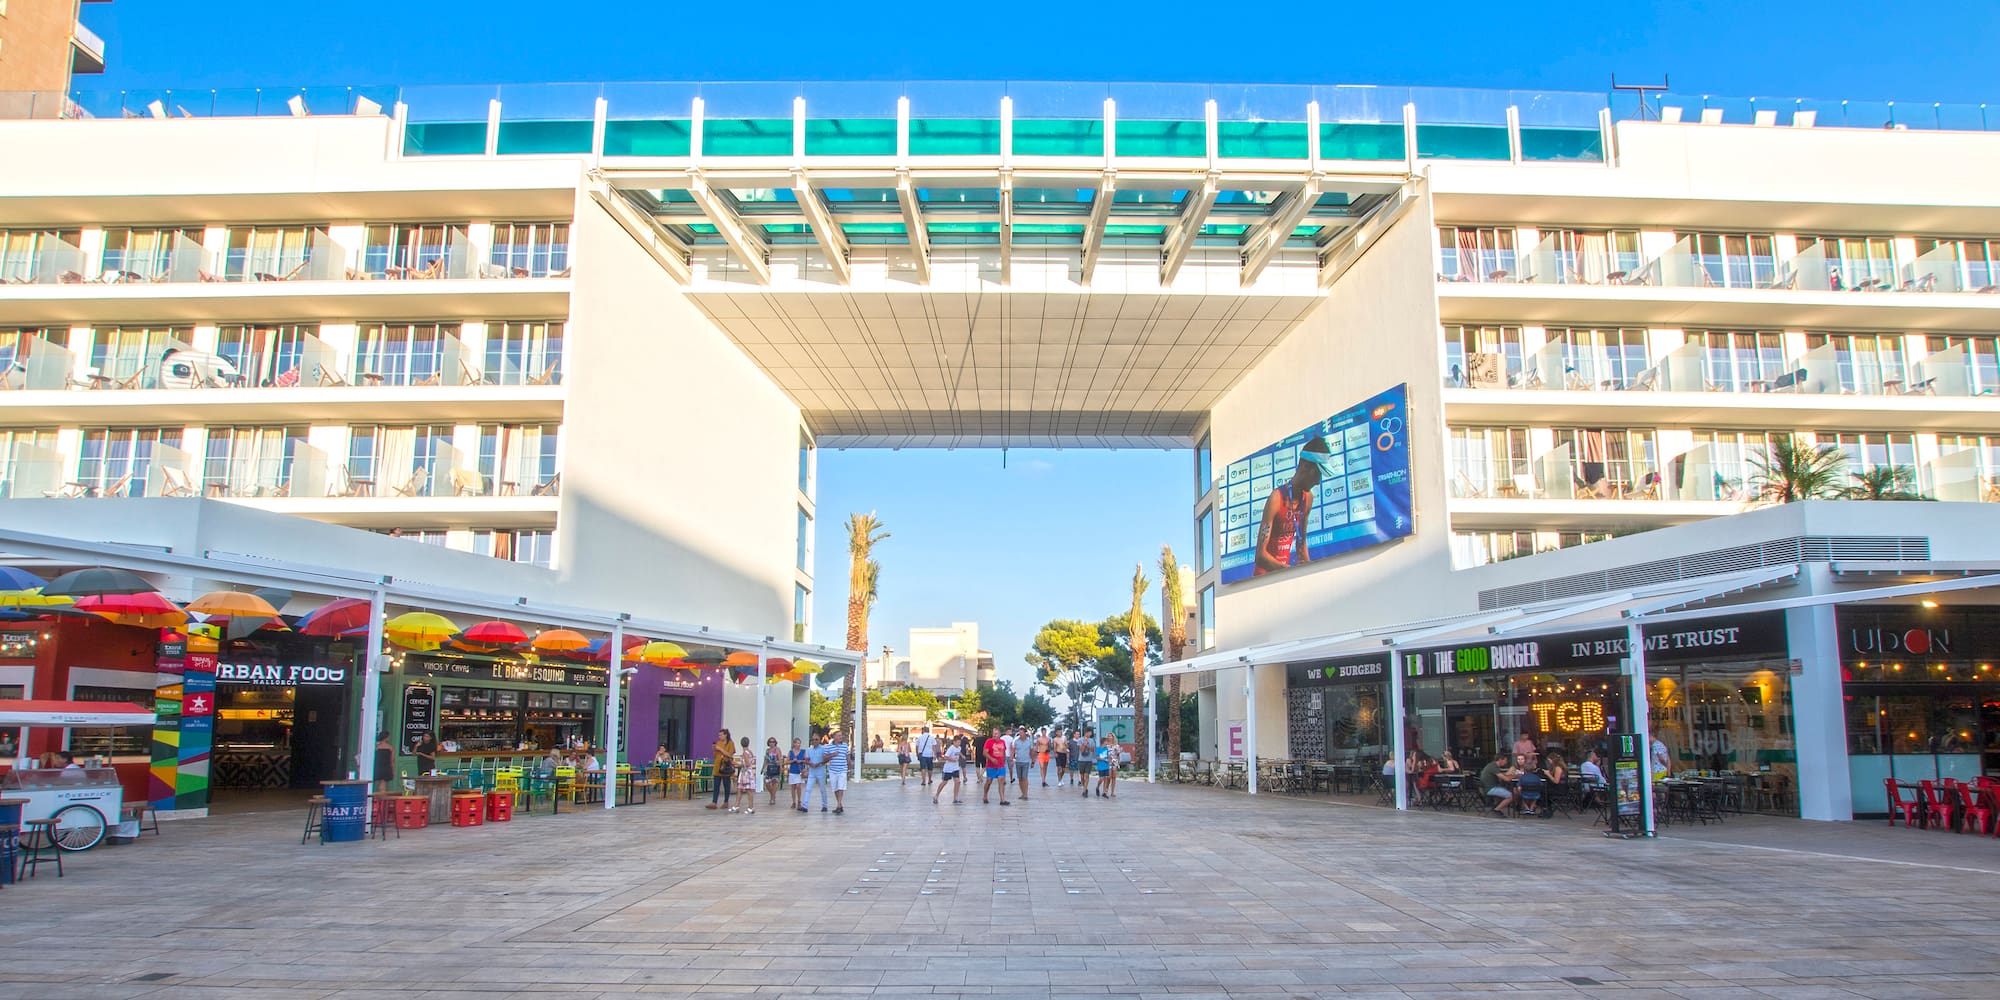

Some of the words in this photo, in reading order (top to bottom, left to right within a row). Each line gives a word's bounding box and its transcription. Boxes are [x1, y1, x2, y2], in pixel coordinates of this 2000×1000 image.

[1333, 486, 1344, 494] NTT
[1571, 643, 1591, 657] IN
[1672, 627, 1739, 649] TRUST
[1852, 628, 1949, 654] UDON
[424, 662, 442, 671] VINOS
[1405, 653, 1424, 676] TGB
[1433, 650, 1455, 674] THE
[1457, 647, 1488, 672] GOOD
[1490, 642, 1540, 670] BURGER
[289, 665, 345, 681] FOOD
[492, 664, 502, 678] EL
[533, 667, 565, 682] ESQUINA
[1307, 669, 1321, 680] WE
[1339, 663, 1381, 677] BURGERS
[1531, 701, 1605, 732] TGB
